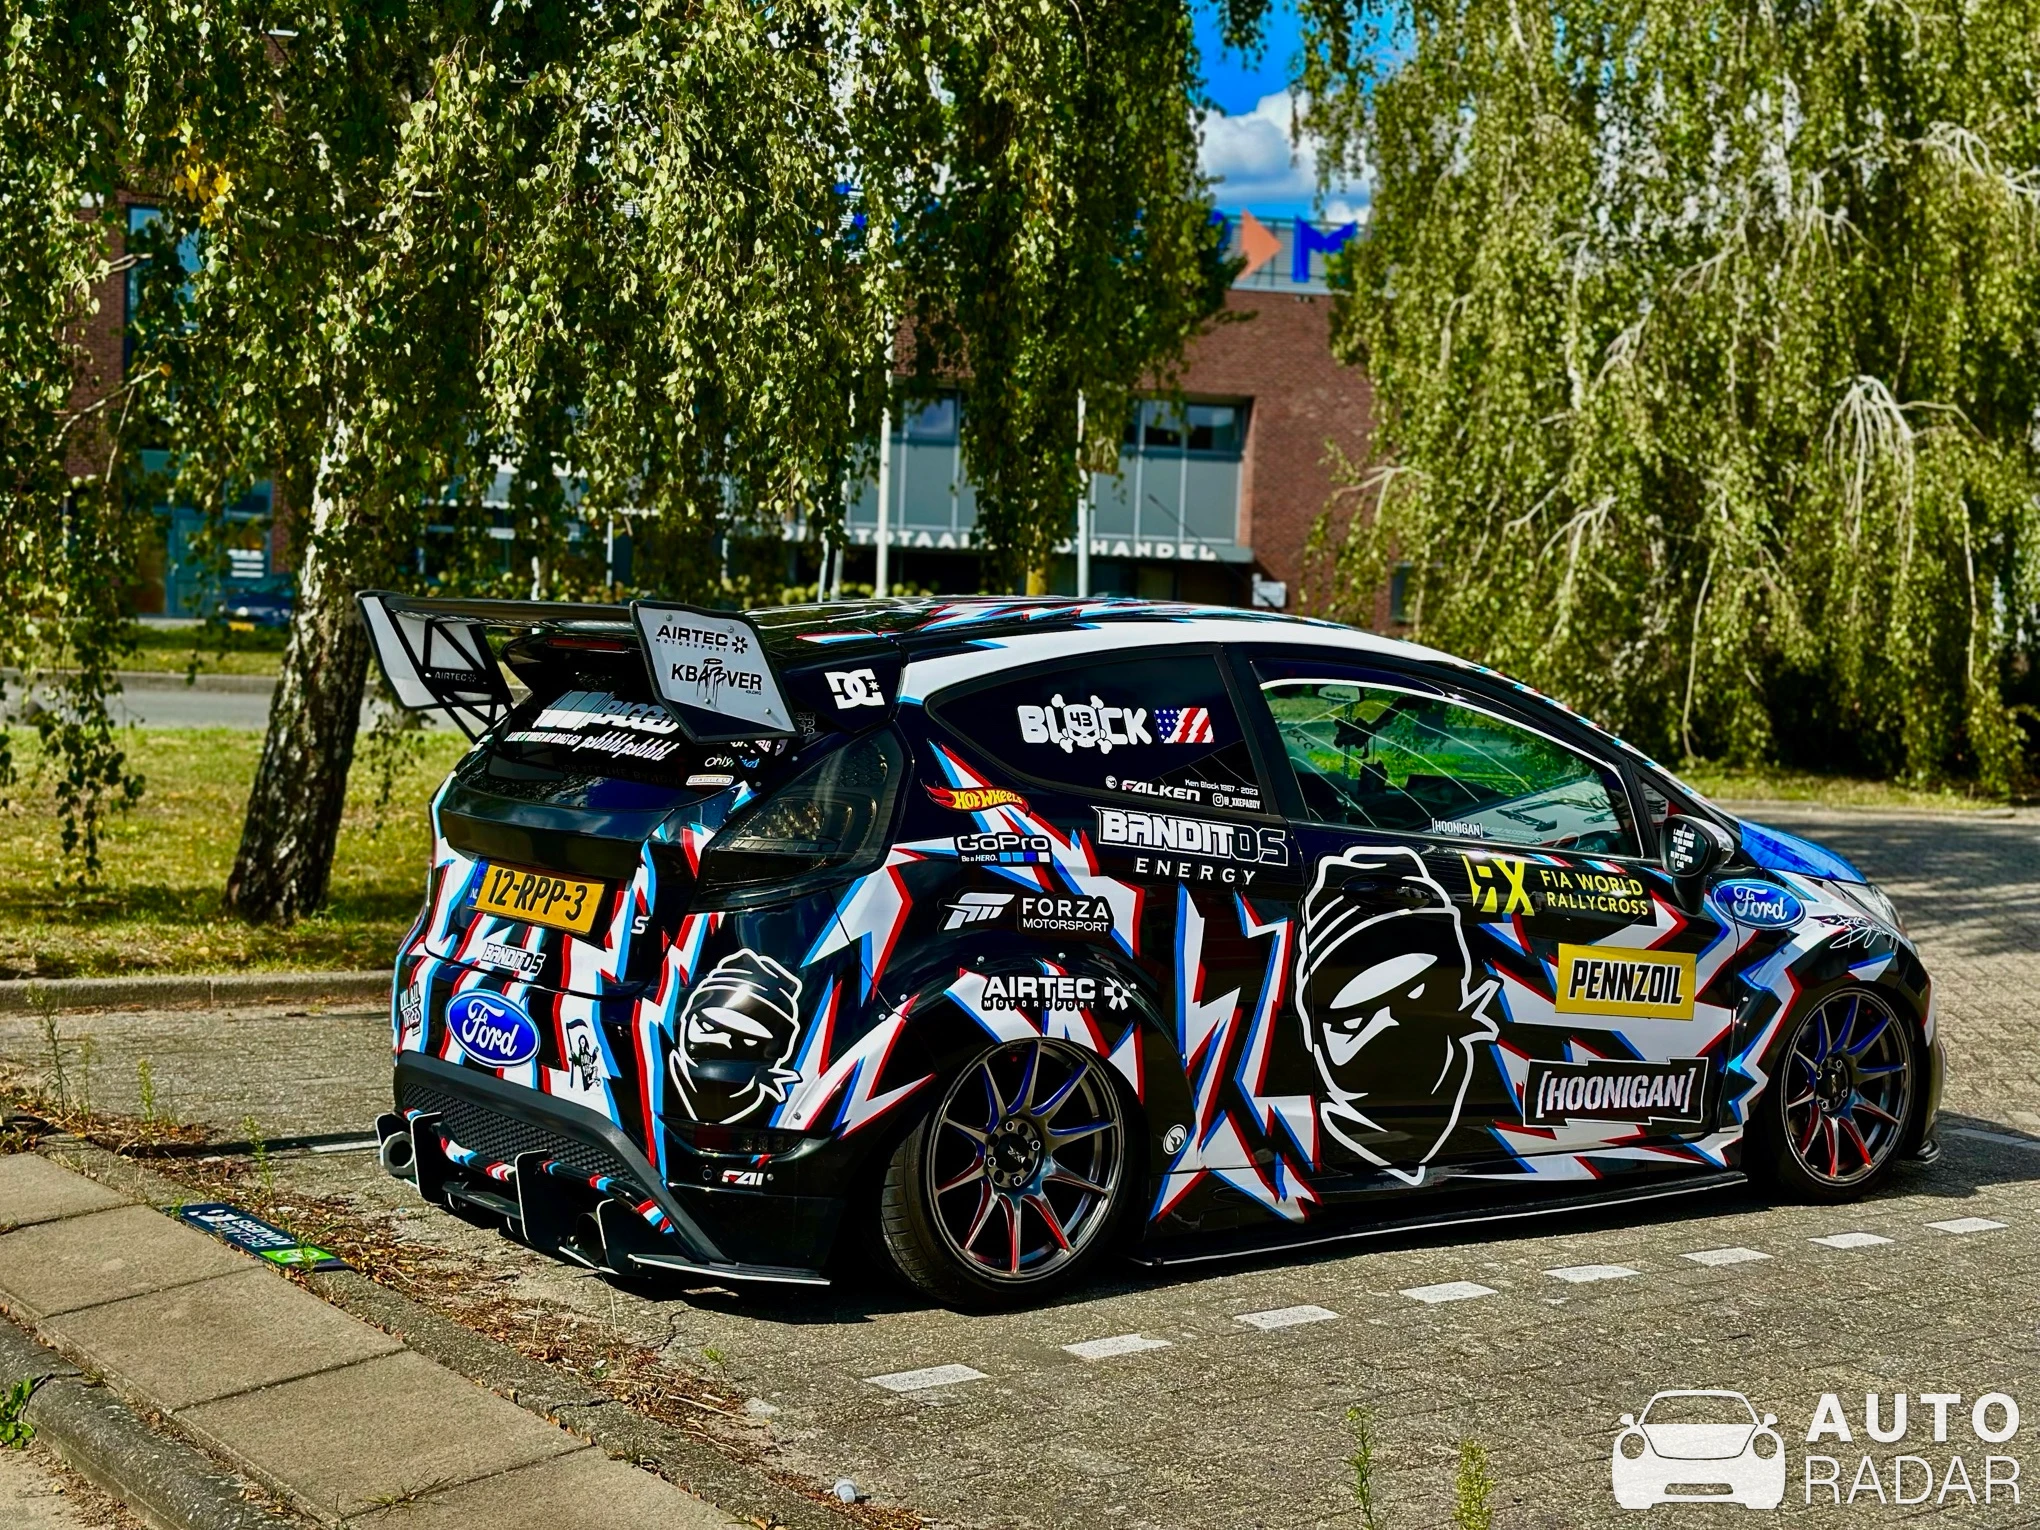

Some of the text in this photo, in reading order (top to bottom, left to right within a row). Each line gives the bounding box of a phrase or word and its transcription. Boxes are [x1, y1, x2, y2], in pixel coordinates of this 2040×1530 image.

[655, 638, 727, 653] MOTORSPORT
[656, 624, 729, 647] AIRTEC
[434, 671, 467, 682] AIRTEC
[1070, 711, 1093, 728] 43
[1121, 779, 1200, 802] FALKEN
[1185, 779, 1199, 788] Ken
[1200, 781, 1219, 791] Block
[1240, 786, 1259, 796] 2023
[1097, 806, 1288, 867] BANDITOS
[1431, 817, 1484, 838] [HOONIGAN]
[956, 834, 1049, 851] GoPro
[975, 854, 998, 862] HERO.
[1135, 857, 1256, 886] ENERGY
[1540, 869, 1644, 896] FIA WORLD
[488, 868, 588, 922] 12-RPP-3
[1461, 855, 1535, 916] RX
[1022, 897, 1109, 920] FORZA
[1546, 891, 1649, 916] RALLYCROSS
[1732, 885, 1789, 922] Ford
[1022, 917, 1109, 932] MOTORSPORT
[480, 942, 547, 977] BANDITOS
[984, 976, 1096, 999] AIRTEC
[1568, 957, 1683, 1005] PENNZOIL
[984, 999, 1095, 1009] MOTORSPORT
[461, 998, 520, 1058] Ford
[1536, 1066, 1697, 1119] [HOONIGAN]
